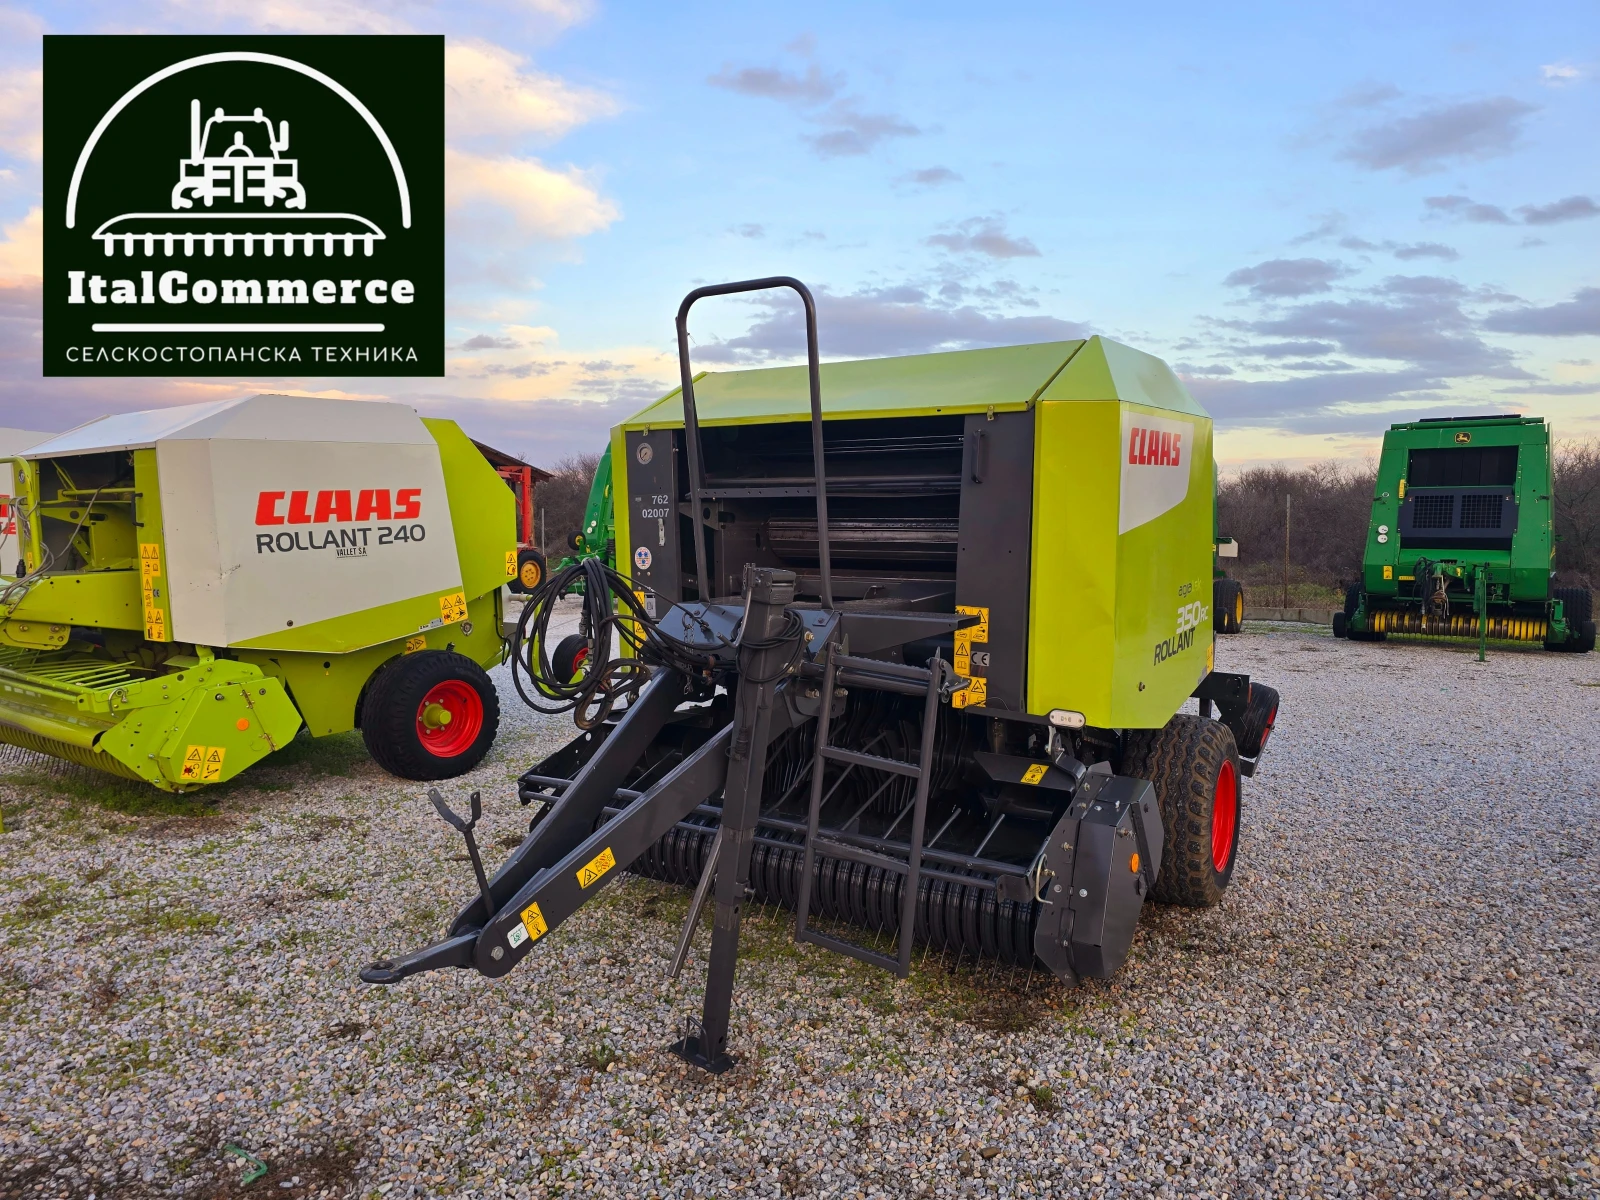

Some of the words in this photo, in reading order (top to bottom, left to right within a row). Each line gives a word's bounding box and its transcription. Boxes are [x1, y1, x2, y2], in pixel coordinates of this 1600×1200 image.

[1128, 427, 1182, 467] CLAAS
[254, 488, 422, 526] CLAAS
[642, 508, 670, 518] 02007
[651, 494, 669, 505] 762
[256, 527, 373, 554] ROLLANT
[377, 523, 426, 546] 240
[336, 547, 357, 557] VALLET
[1153, 626, 1196, 667] ROLLANT
